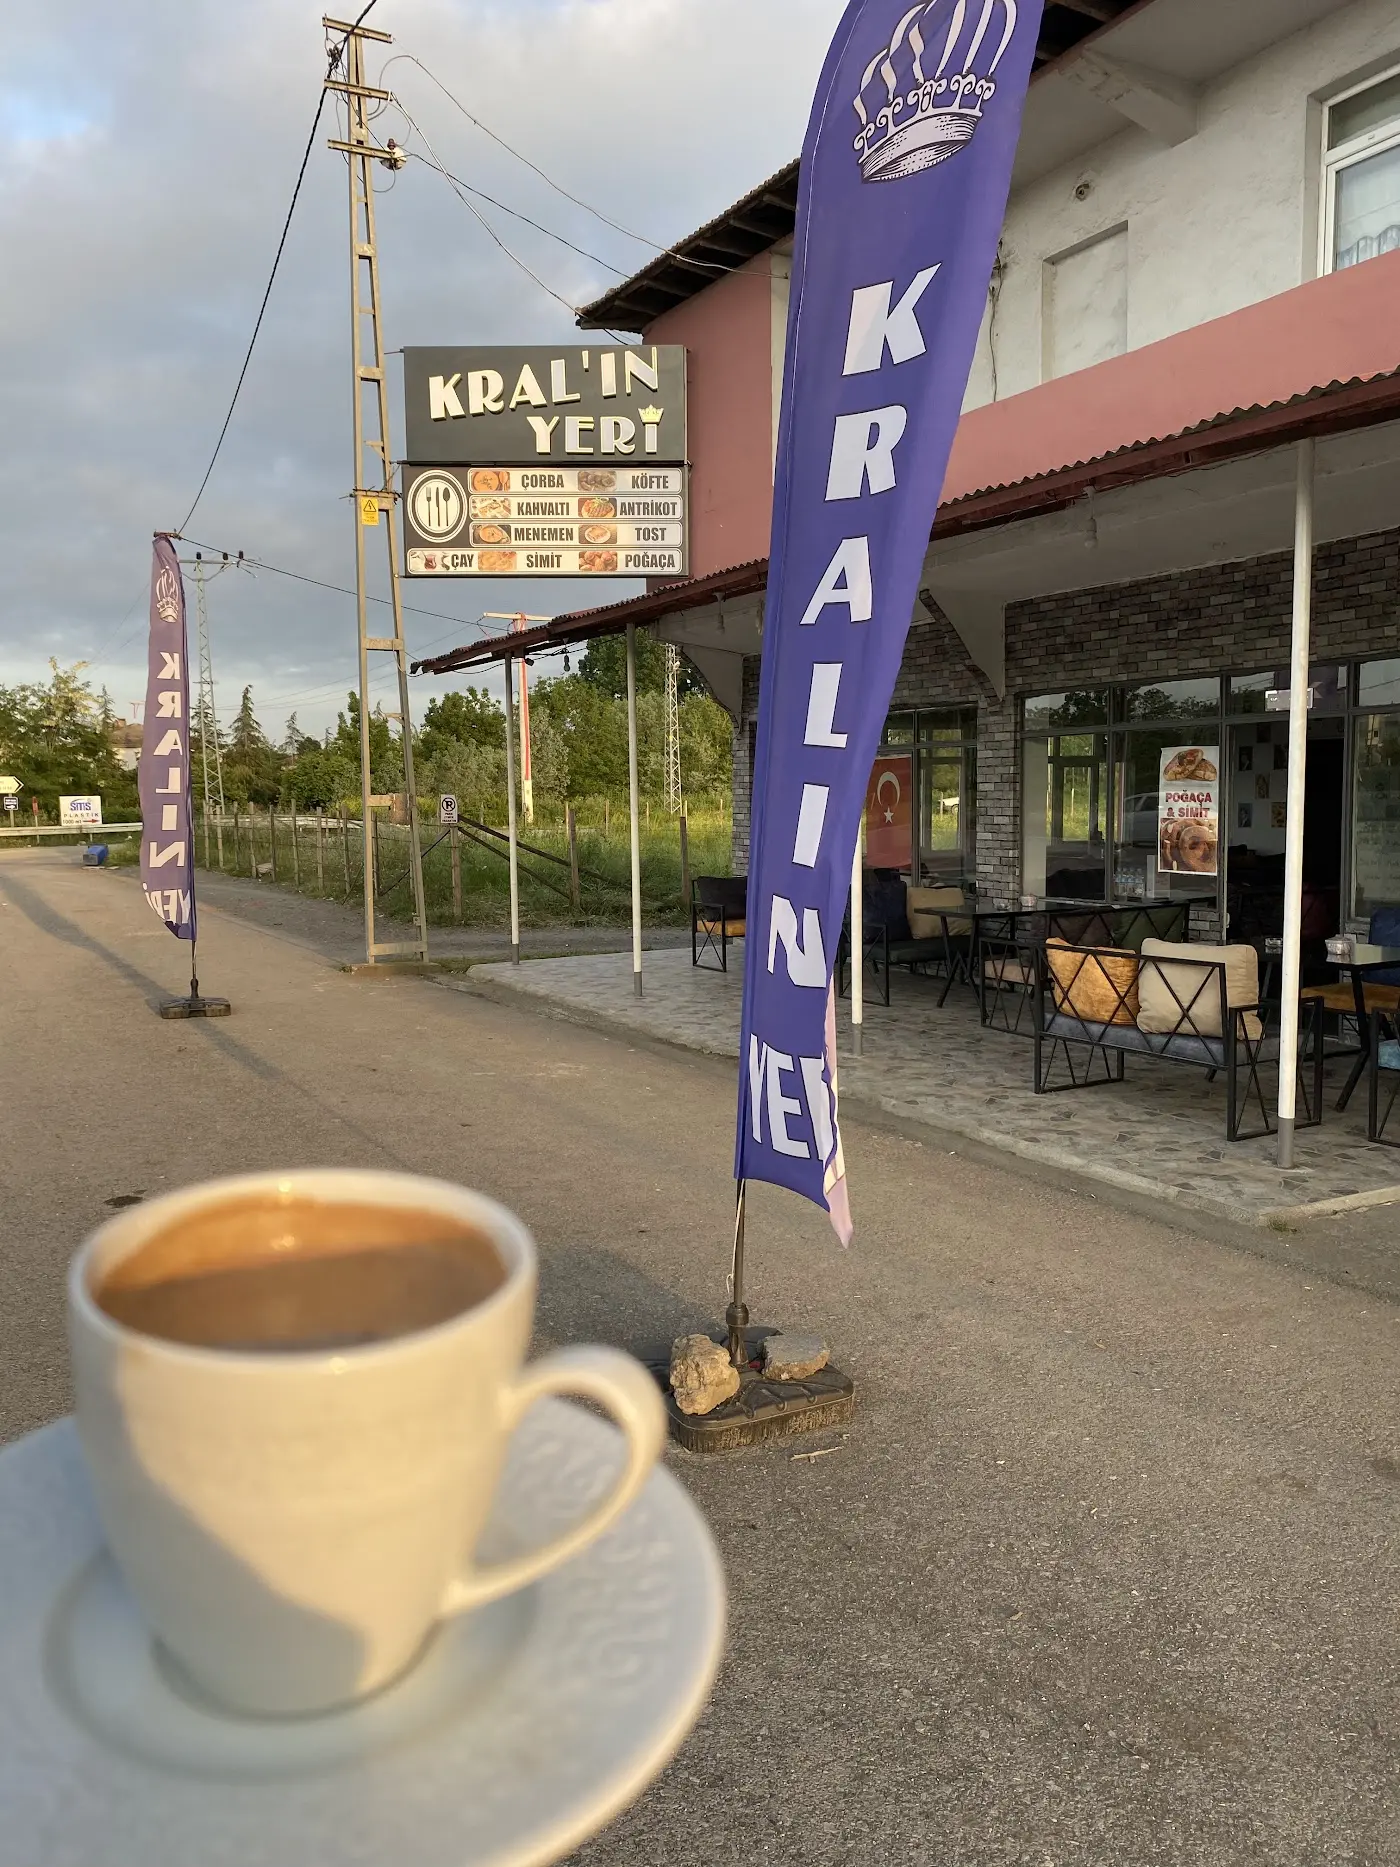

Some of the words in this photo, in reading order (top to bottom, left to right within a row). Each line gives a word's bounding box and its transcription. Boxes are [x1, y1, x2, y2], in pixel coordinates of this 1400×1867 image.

[428, 347, 659, 422] KRAL'IN
[521, 474, 565, 490] ÇORBA
[631, 473, 669, 489] KÖFTE
[517, 502, 570, 517] KAHVALTI
[619, 499, 678, 516] ANTRİKOT
[514, 527, 574, 542] MENEMEN
[635, 527, 667, 542] TOST
[450, 554, 474, 570] ÇAY
[526, 552, 563, 568] SİMİT
[625, 552, 676, 570] POĞAÇA
[767, 262, 942, 988] KRALIN
[1165, 789, 1212, 806] POĞAÇA
[1167, 807, 1175, 818] &
